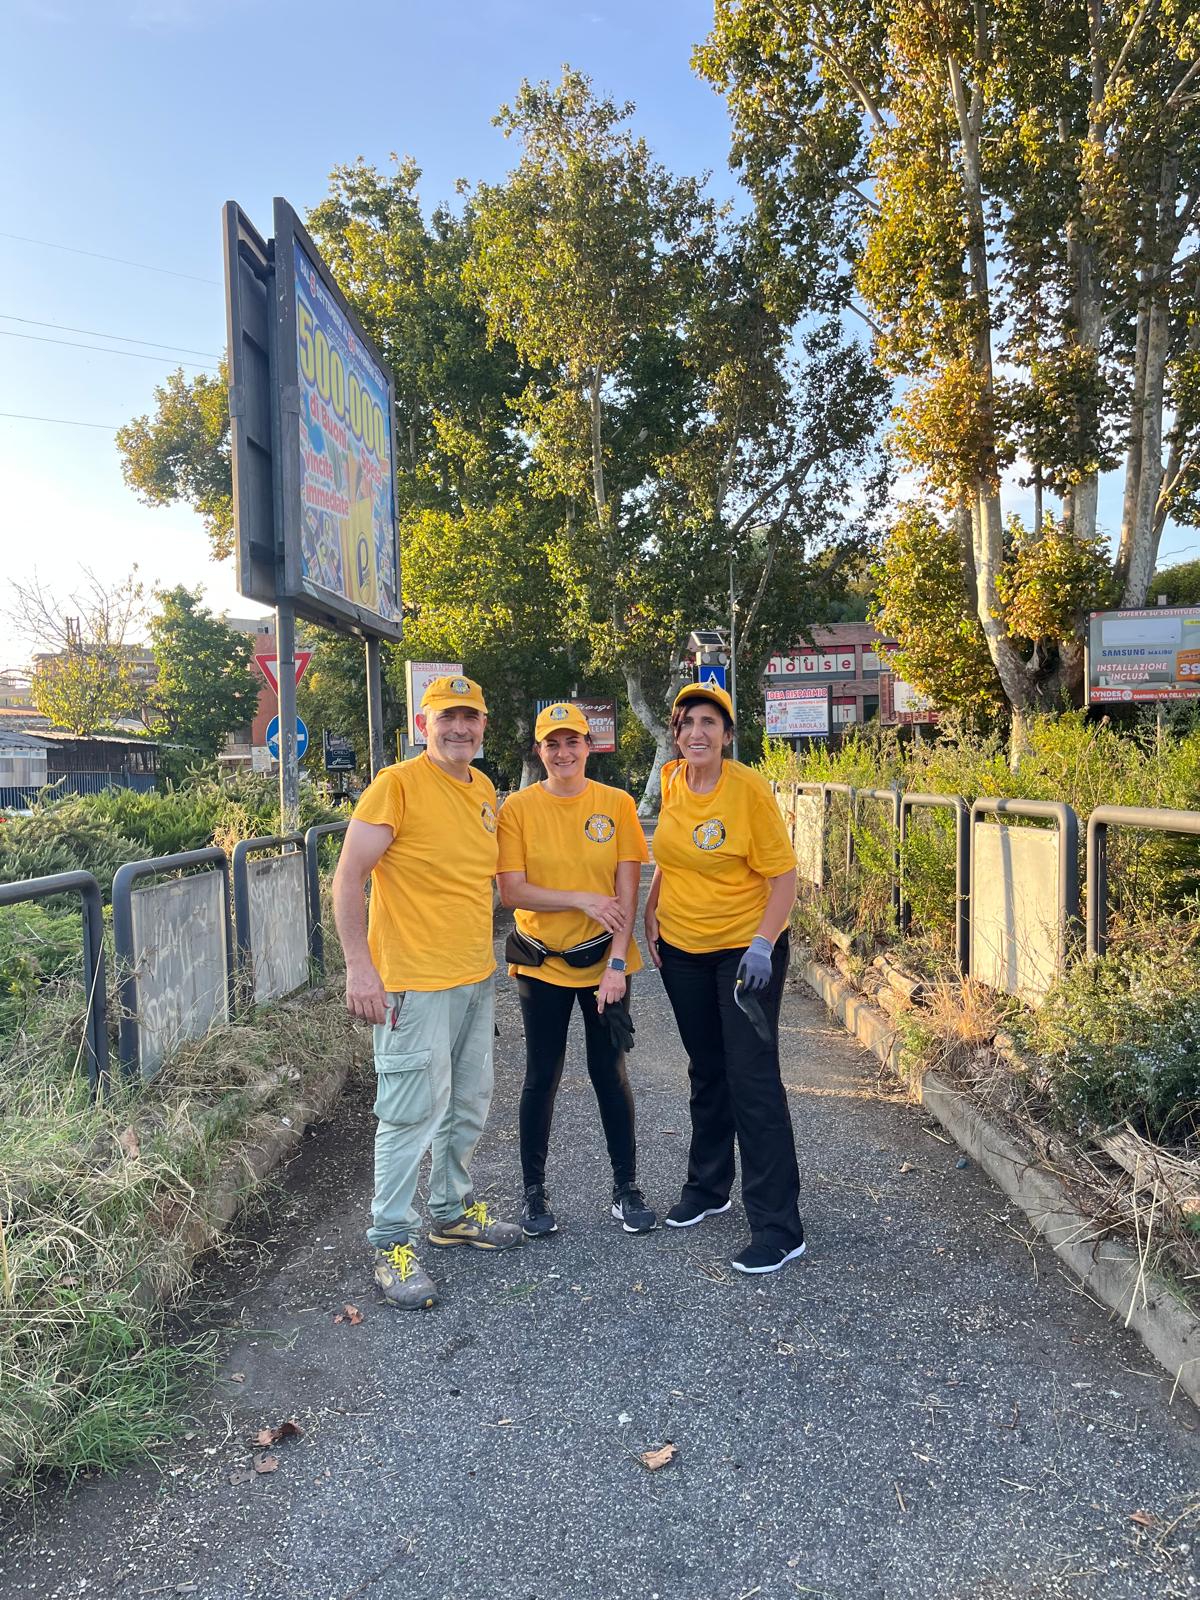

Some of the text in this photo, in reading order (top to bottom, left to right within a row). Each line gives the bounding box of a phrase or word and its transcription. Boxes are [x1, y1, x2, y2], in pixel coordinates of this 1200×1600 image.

[298, 296, 385, 463] 500.000
[321, 404, 348, 451] Buoni
[305, 477, 349, 516] immediate
[1102, 649, 1145, 657] SAMSUNG
[1097, 663, 1168, 672] INSTALLAZIONE
[767, 688, 828, 700] IDEA RISPARMIO
